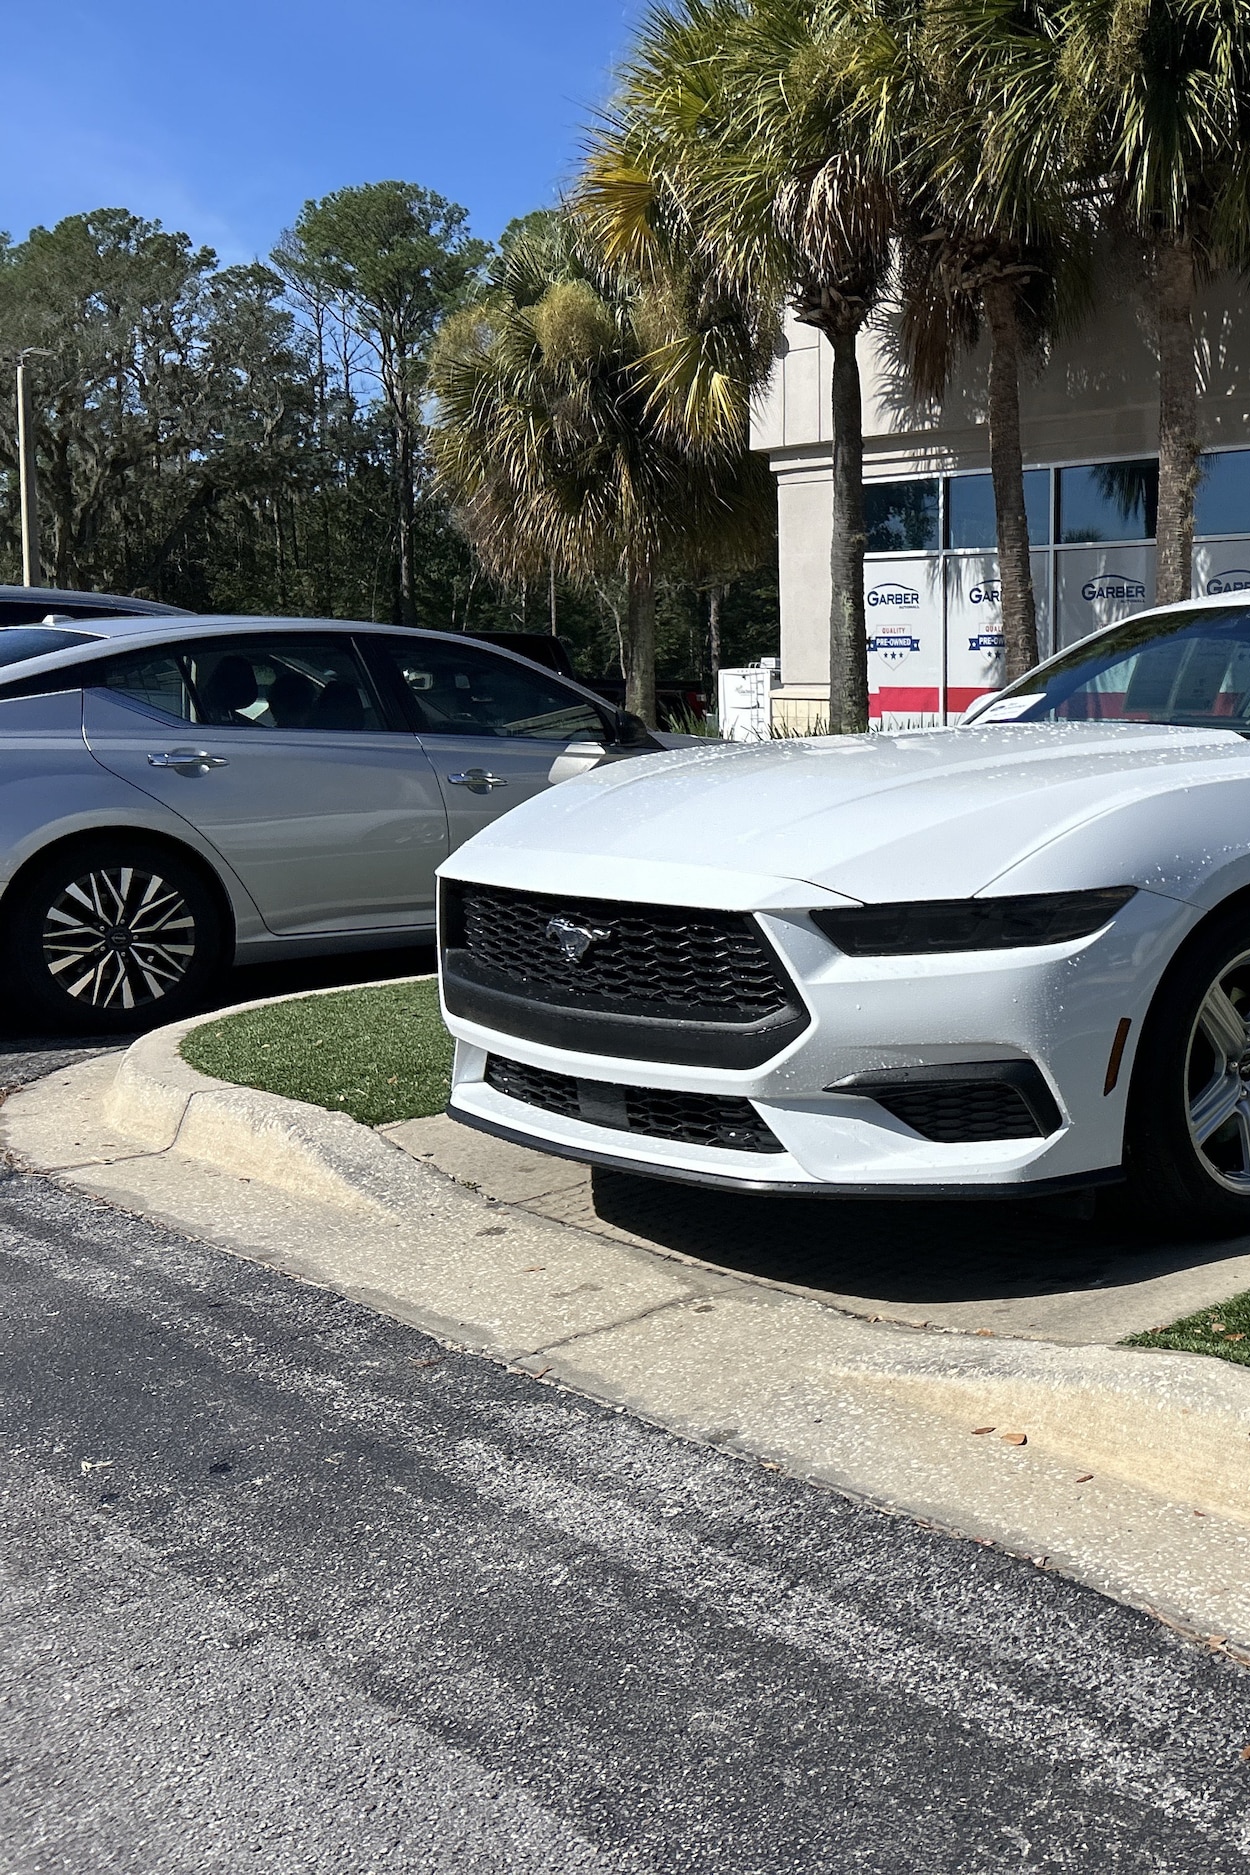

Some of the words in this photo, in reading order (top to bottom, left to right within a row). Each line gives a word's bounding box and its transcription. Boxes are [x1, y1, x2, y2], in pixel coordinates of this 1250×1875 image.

[867, 590, 920, 606] GARBER
[969, 588, 1002, 604] GAR
[1081, 583, 1145, 601] GARBER
[876, 638, 912, 646] PRE-OWNED
